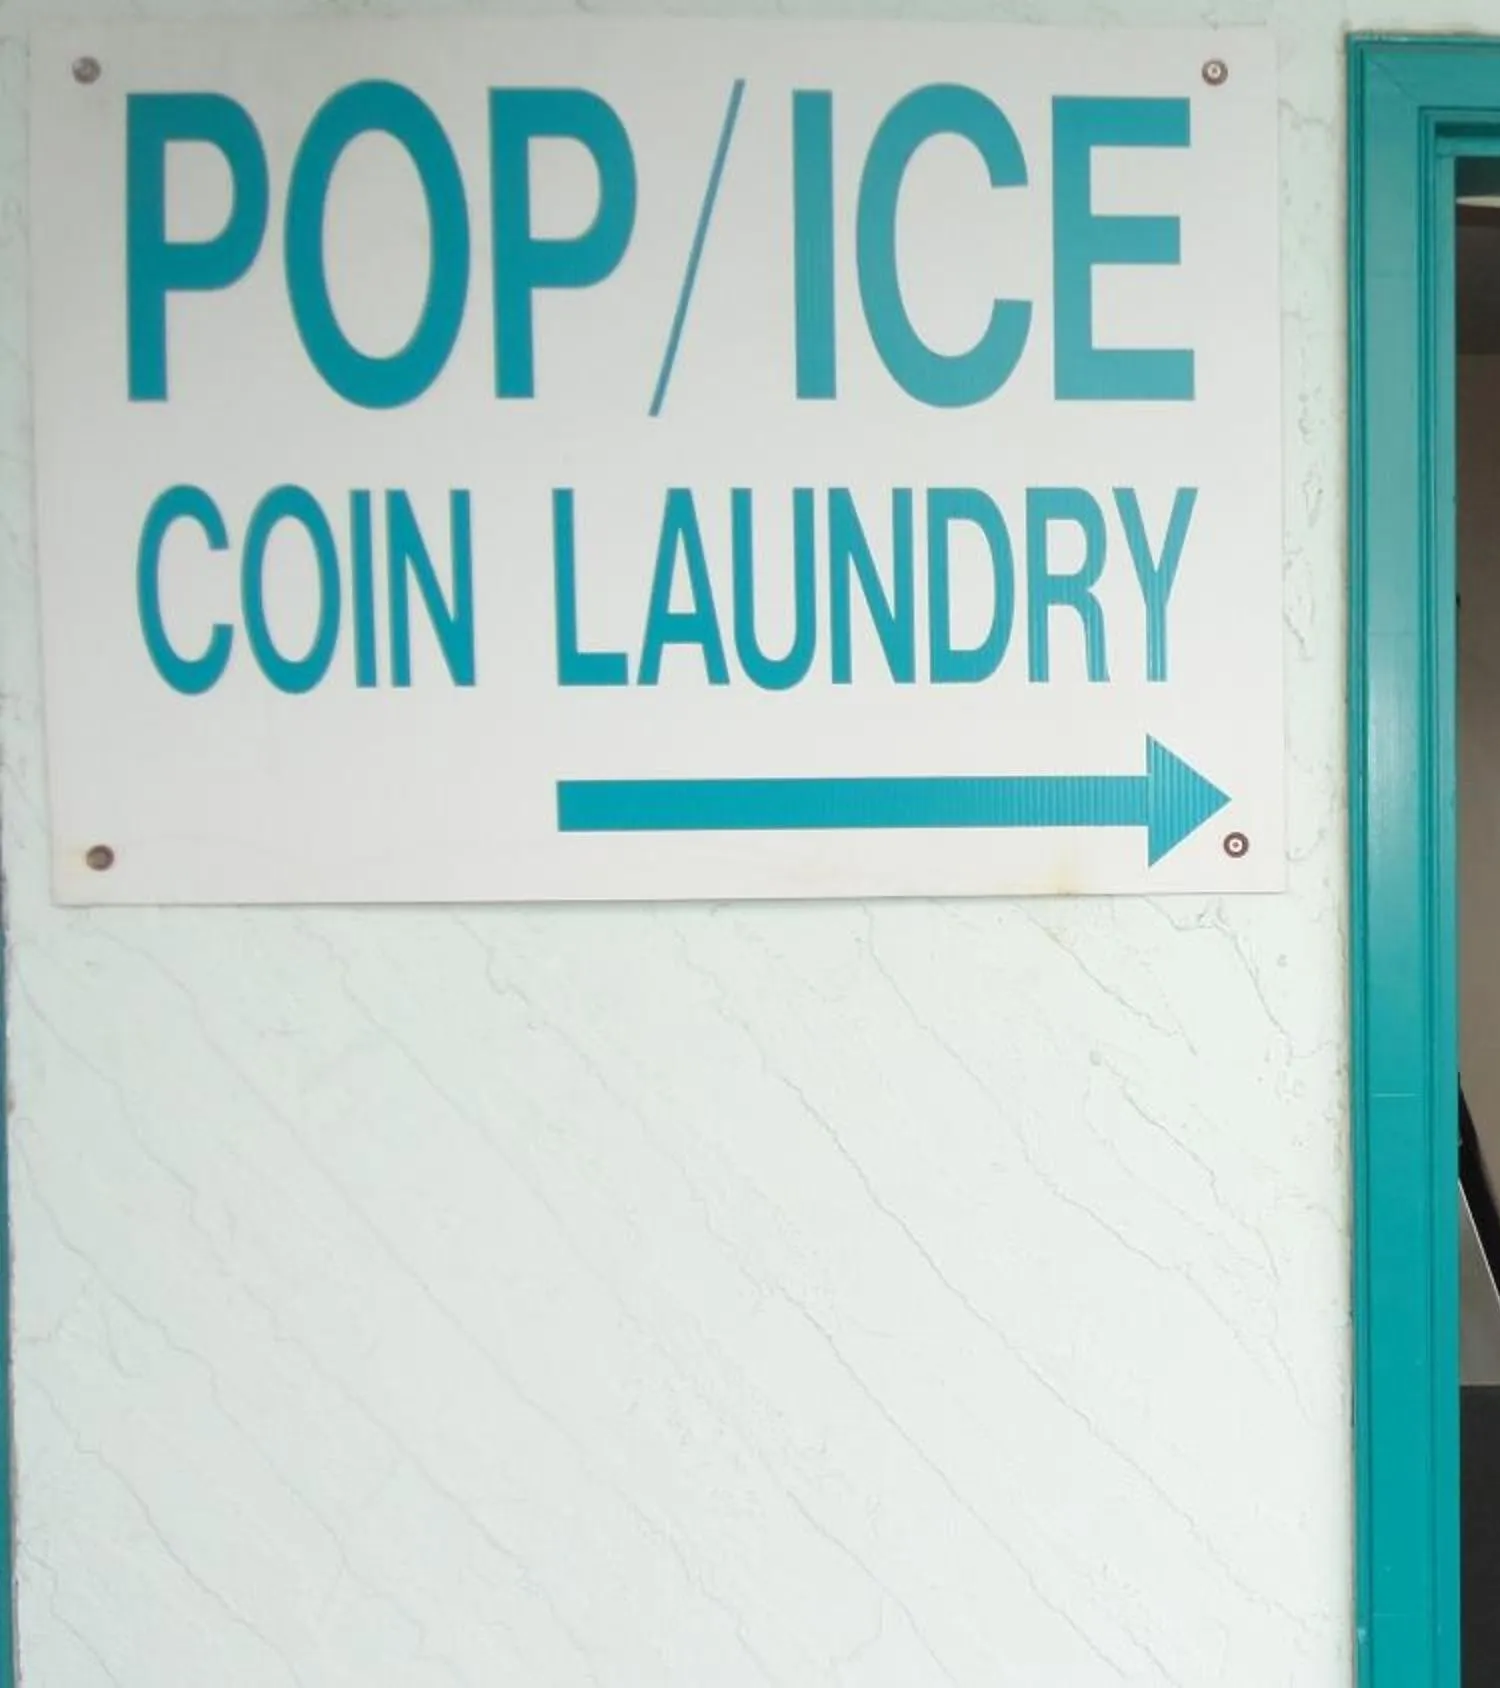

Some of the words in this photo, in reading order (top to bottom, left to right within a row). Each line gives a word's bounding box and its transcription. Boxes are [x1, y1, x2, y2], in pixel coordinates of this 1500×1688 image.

[125, 78, 1196, 417] POP/ICE
[137, 484, 477, 696] COIN
[552, 487, 1198, 692] LAUNDRY
